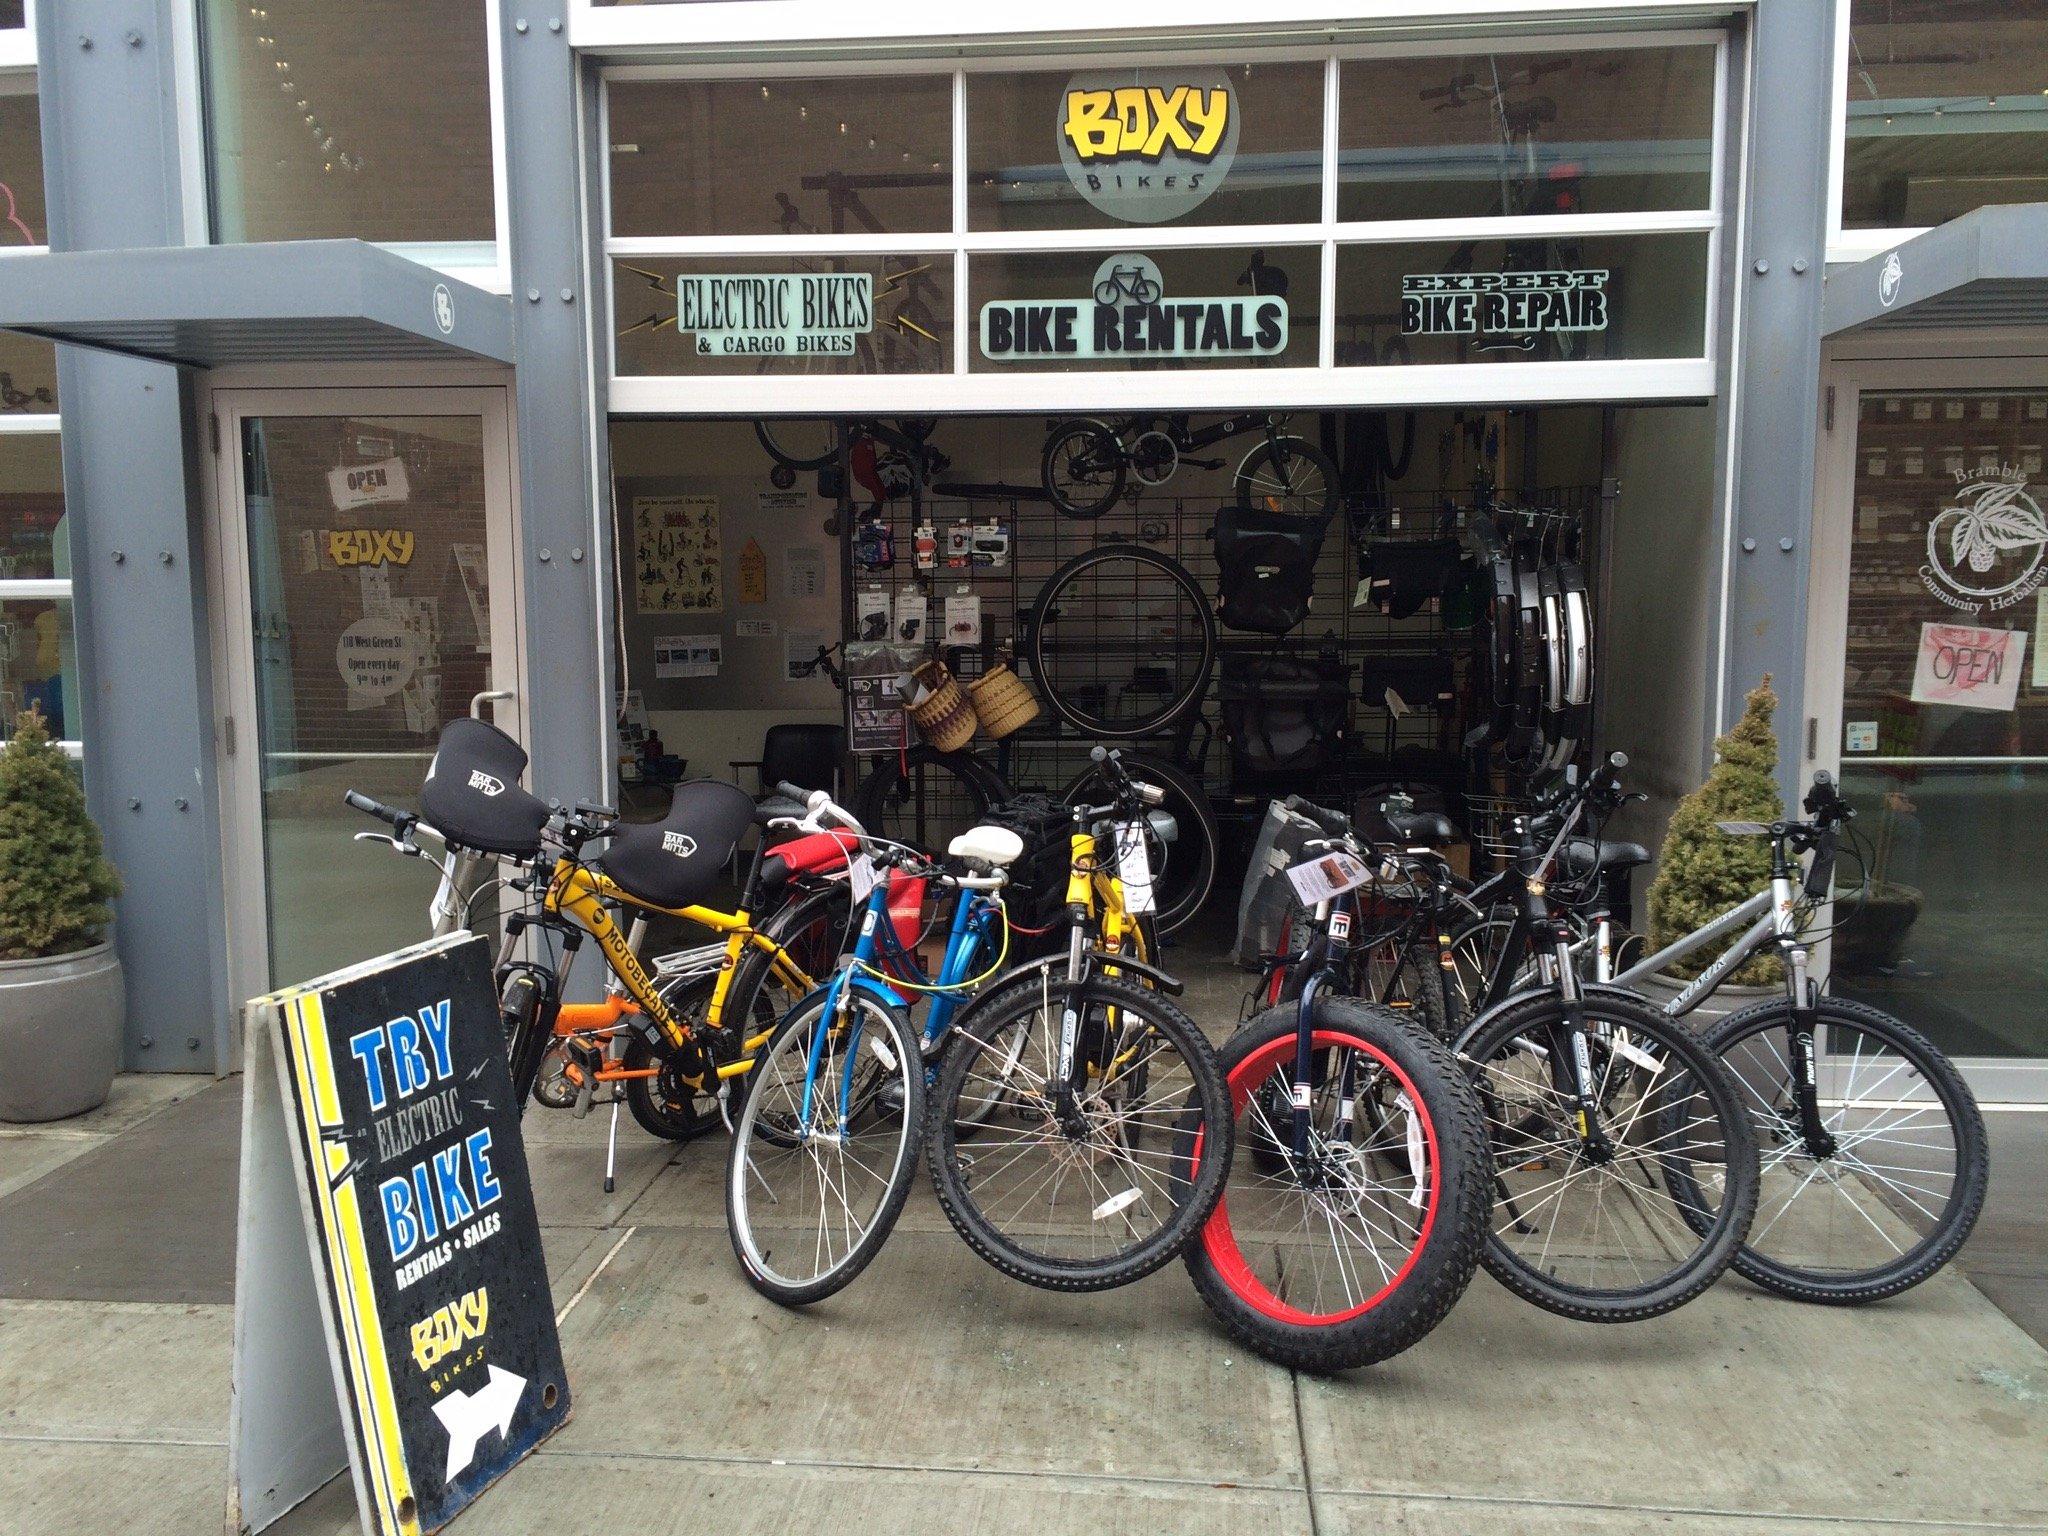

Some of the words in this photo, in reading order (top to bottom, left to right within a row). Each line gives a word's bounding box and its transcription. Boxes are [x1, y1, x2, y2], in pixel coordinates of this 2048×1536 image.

[1064, 86, 1229, 163] BOXY
[1086, 173, 1204, 191] BIKES
[1403, 270, 1609, 293] EXPERT
[682, 278, 789, 330] ELECTRIC
[801, 276, 869, 329] BIKES
[1401, 293, 1477, 334] BIKE
[1483, 290, 1609, 333] REPAIR
[698, 337, 712, 353] &
[723, 335, 785, 353] CARGO
[796, 335, 853, 352] BIKES
[988, 306, 1077, 352] BIKE
[1093, 302, 1282, 351] RENTALS
[346, 468, 388, 491] OPEN
[1953, 462, 2027, 484] Bramble
[328, 530, 415, 568] BOXY
[1918, 564, 1984, 615] Community
[1988, 566, 2048, 611] Herbalism
[354, 636, 371, 648] West
[372, 636, 395, 648] Green
[348, 658, 366, 671] Open
[367, 660, 386, 671] every
[387, 658, 400, 671] day
[1933, 646, 2004, 684] OPEN
[467, 778, 497, 794] MITTS
[471, 771, 492, 786] BAR
[661, 841, 690, 855] MITTS
[664, 833, 684, 846] BAR
[350, 999, 453, 1112] TRY
[374, 1086, 464, 1164] ELECTRIC
[378, 1127, 502, 1262] BIKE
[395, 1241, 452, 1291] RENTALS
[462, 1211, 501, 1249] SALES
[410, 1287, 488, 1372] BOXY
[430, 1346, 485, 1393] BIKES
